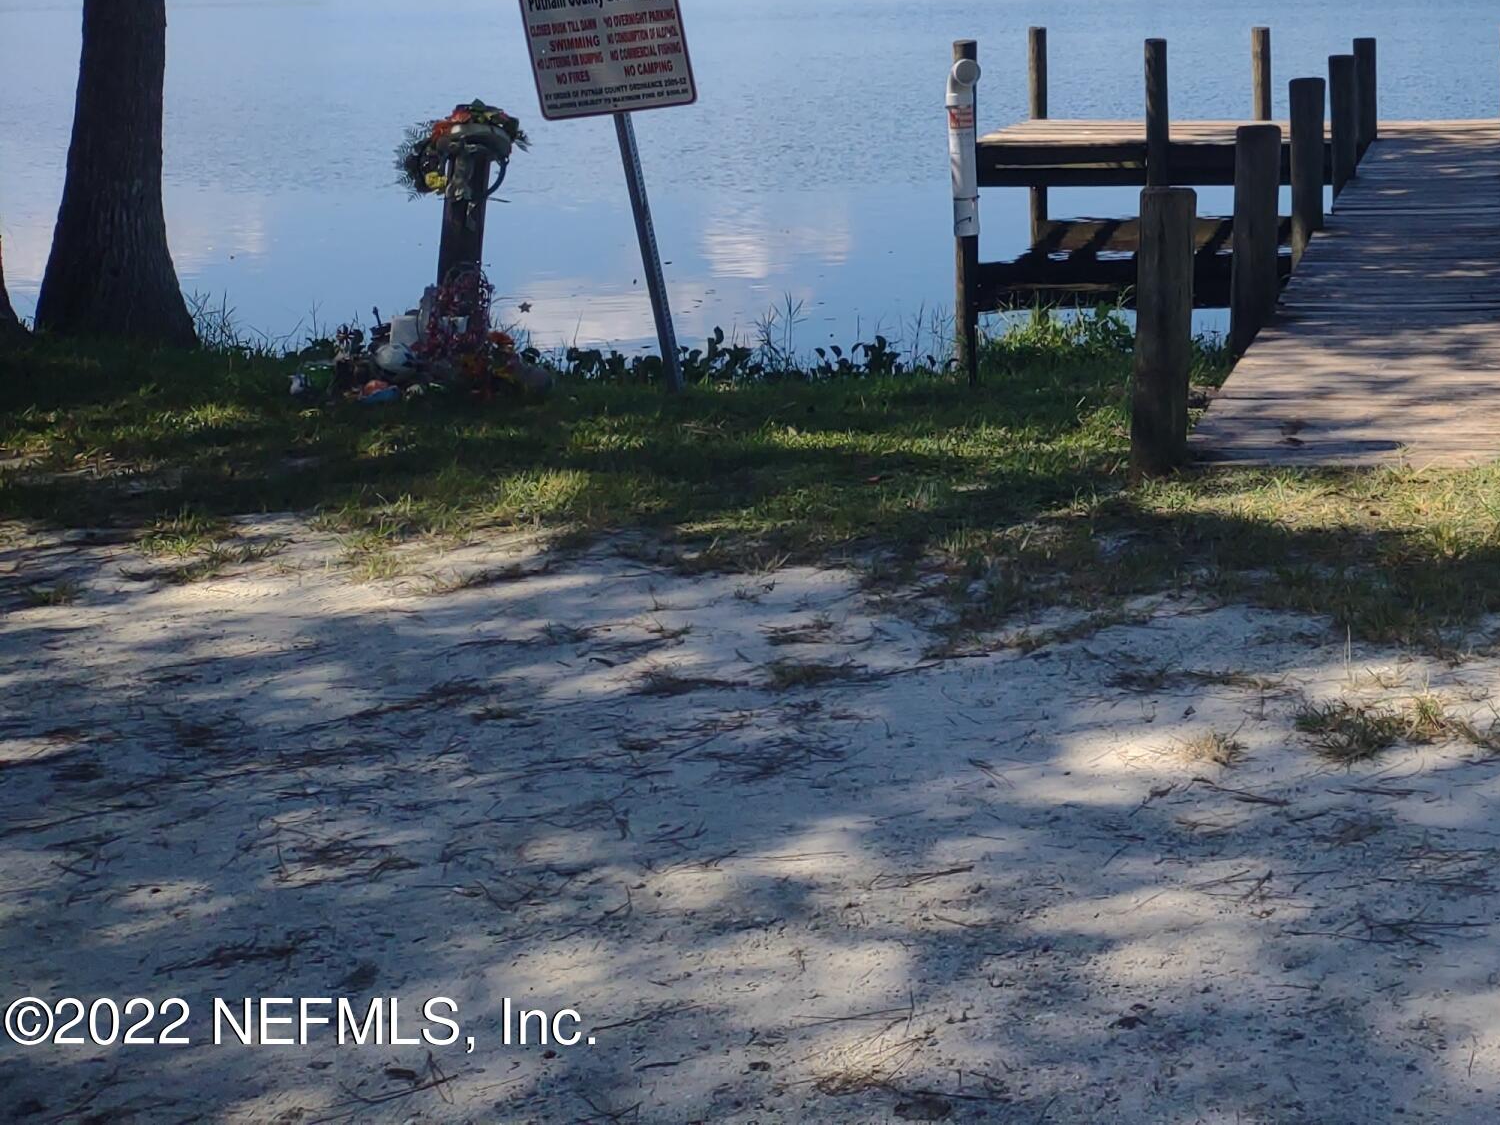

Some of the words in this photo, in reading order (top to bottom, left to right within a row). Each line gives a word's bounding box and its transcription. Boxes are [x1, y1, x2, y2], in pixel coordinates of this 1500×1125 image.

[604, 16, 613, 27] NO
[614, 11, 647, 26] OVERNIGHT
[648, 9, 675, 22] PARKING
[530, 24, 551, 37] CLOSED
[551, 22, 567, 35] DUSK
[567, 20, 580, 32] TILL
[580, 18, 597, 31] DAWN
[607, 33, 615, 44] NO
[615, 30, 648, 43] CONSUMPTION
[649, 28, 655, 39] OF
[655, 26, 678, 37] ALCOHOL
[549, 35, 600, 52] SWIMMING
[610, 50, 618, 61] NO
[620, 45, 657, 60] COMMERCIAL
[658, 42, 681, 55] FISHING
[556, 72, 567, 84] NO
[568, 70, 591, 84] FIRES
[624, 65, 636, 77] NO
[637, 60, 673, 75] CAMPING
[581, 87, 603, 97] PUTNAM
[605, 85, 628, 94] COUNTY
